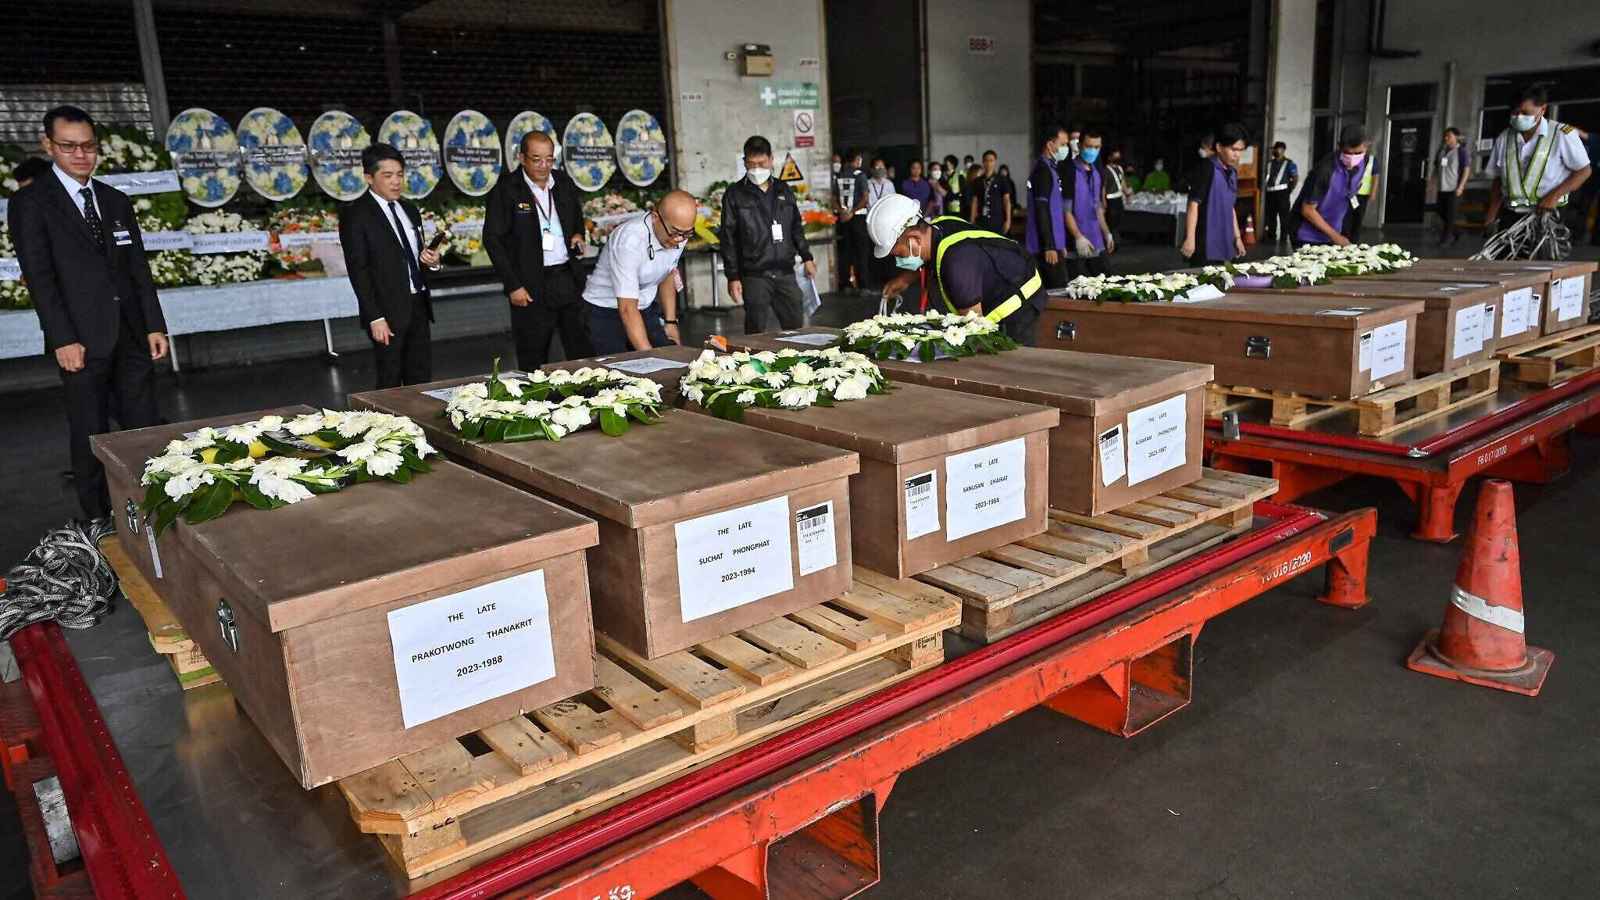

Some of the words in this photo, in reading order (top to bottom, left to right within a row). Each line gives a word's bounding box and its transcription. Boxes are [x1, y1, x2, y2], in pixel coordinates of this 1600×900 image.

[974, 462, 983, 470] THE
[988, 458, 998, 466] LATE
[717, 527, 730, 536] THE
[738, 520, 753, 531] LATE
[698, 552, 724, 566] SUCHAT
[732, 539, 771, 556] PHONGPHAT
[721, 566, 756, 583] 2023-1994
[447, 612, 465, 623] THE
[476, 602, 497, 615] LATE
[411, 636, 475, 663] PRAKOTWONG
[486, 618, 533, 640] THANAKRIT
[456, 655, 504, 678] 2023-1988
